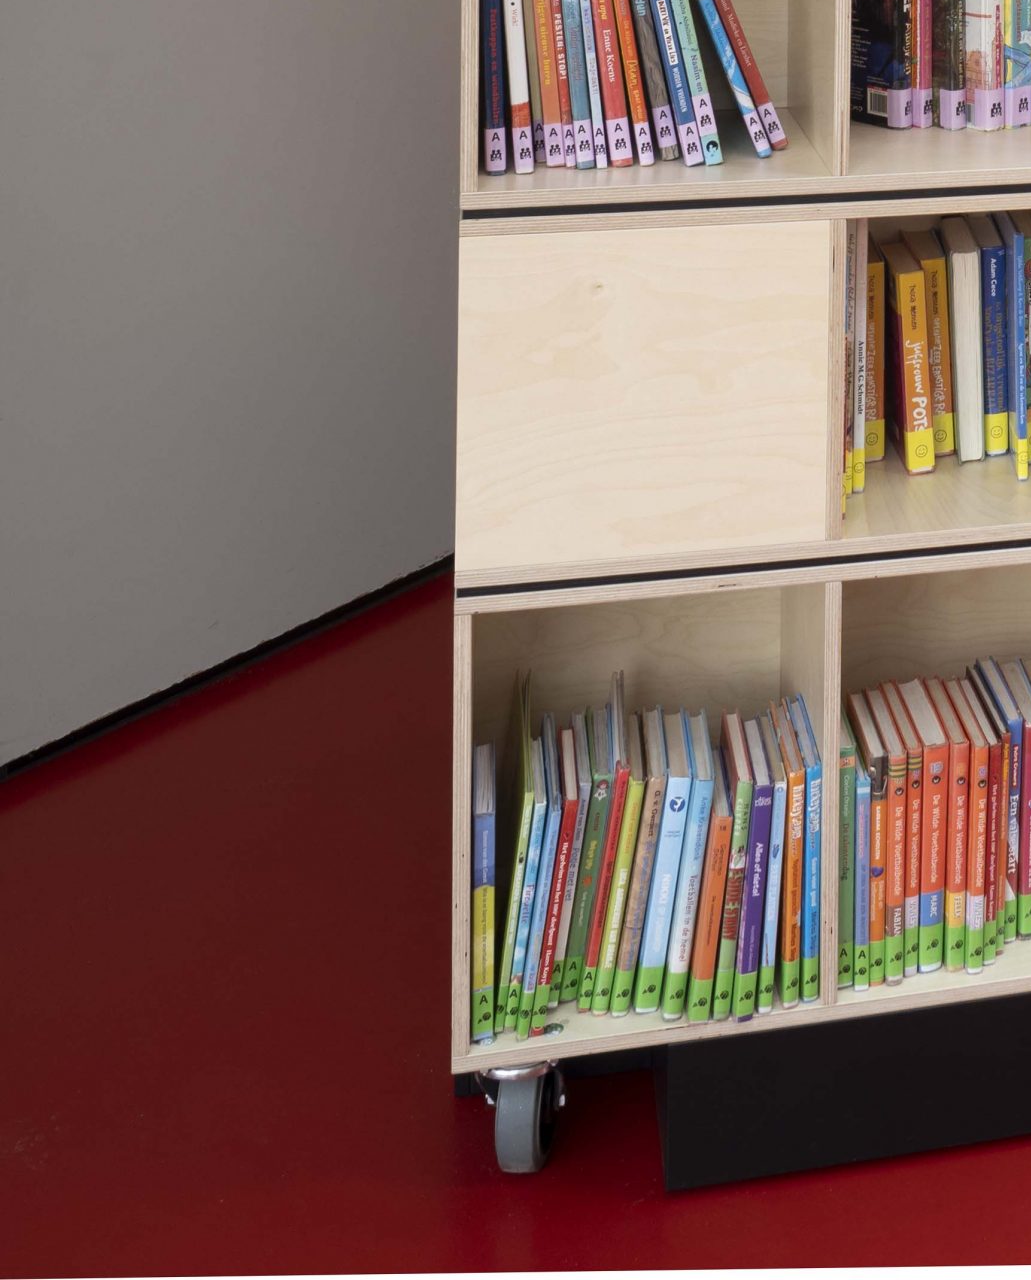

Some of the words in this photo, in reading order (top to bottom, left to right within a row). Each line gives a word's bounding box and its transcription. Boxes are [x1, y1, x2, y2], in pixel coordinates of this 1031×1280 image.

[598, 5, 607, 20] opa
[602, 29, 612, 52] Enne
[606, 54, 617, 82] Koens
[905, 339, 924, 393] juffrouw
[912, 799, 920, 810] De
[933, 795, 941, 806] De
[957, 796, 965, 807] De
[978, 798, 985, 809] De
[1010, 794, 1020, 816] Een
[895, 807, 903, 818] De
[911, 812, 920, 833] Wilde
[932, 807, 940, 829] Wilde
[956, 808, 964, 830] Wilde
[977, 811, 985, 833] Wilde
[895, 819, 903, 841] Wilde
[755, 843, 763, 862] Alles
[910, 836, 919, 887] Voetbalbende
[930, 831, 939, 883] Voetbalbende
[954, 832, 963, 884] Voetbalbende
[976, 835, 984, 887] Voetbalbende
[1008, 846, 1016, 873] start
[894, 843, 903, 896] Voetbalbende
[686, 874, 697, 915] Voetballen
[929, 895, 938, 917] MARC
[954, 896, 962, 918] FELIX
[682, 928, 690, 937] de
[680, 939, 688, 962] hemel
